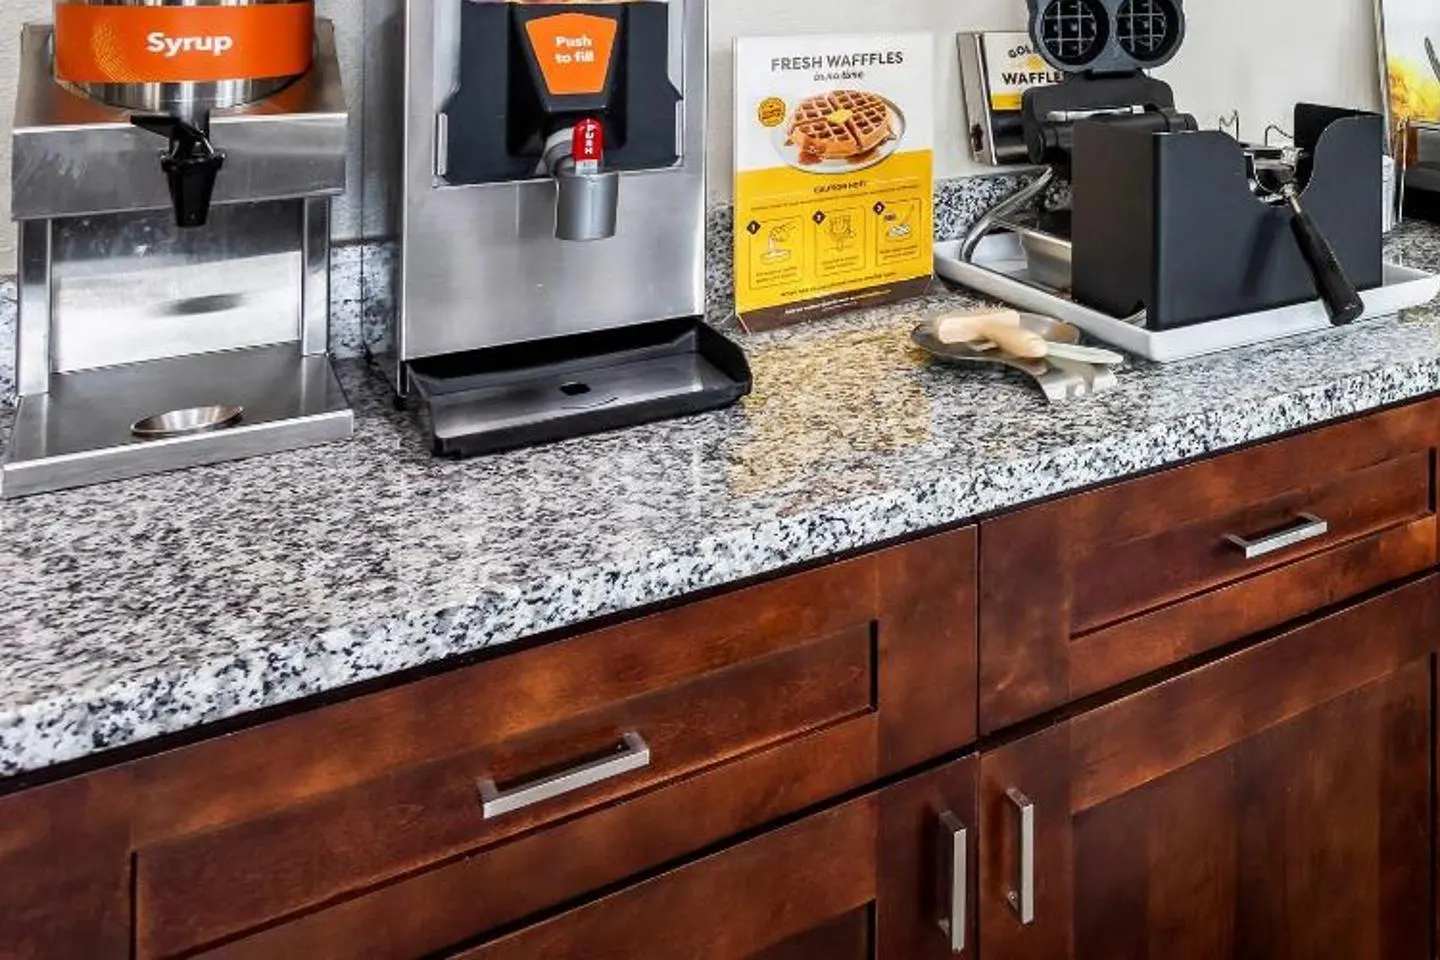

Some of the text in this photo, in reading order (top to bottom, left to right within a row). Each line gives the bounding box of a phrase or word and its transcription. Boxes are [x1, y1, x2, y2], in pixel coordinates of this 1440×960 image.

[147, 31, 233, 58] Syrup
[556, 36, 593, 47] Push
[555, 50, 595, 63] to fill
[771, 55, 823, 71] FRESH
